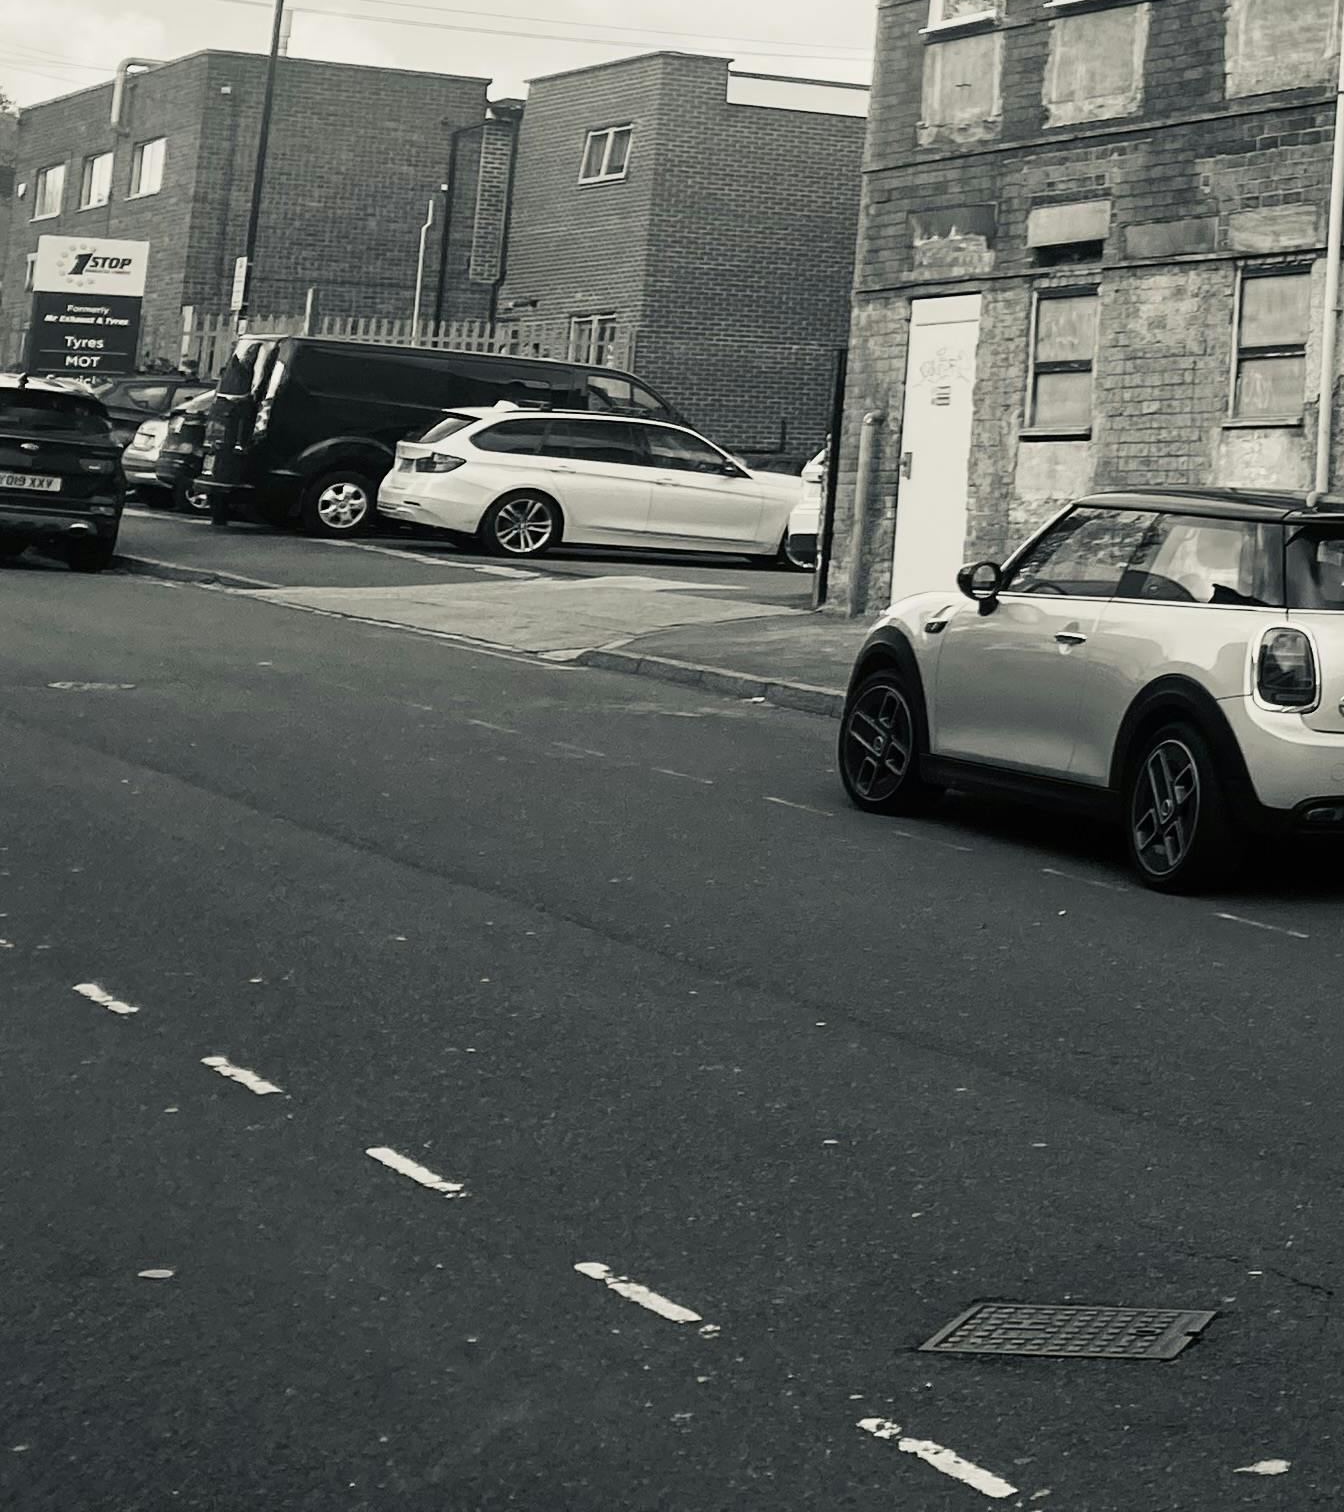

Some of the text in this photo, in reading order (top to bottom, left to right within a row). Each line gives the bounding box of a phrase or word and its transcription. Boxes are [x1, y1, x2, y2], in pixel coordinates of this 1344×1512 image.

[68, 253, 132, 275] 1 STOP
[64, 335, 105, 350] Tyres
[65, 355, 101, 368] MOT
